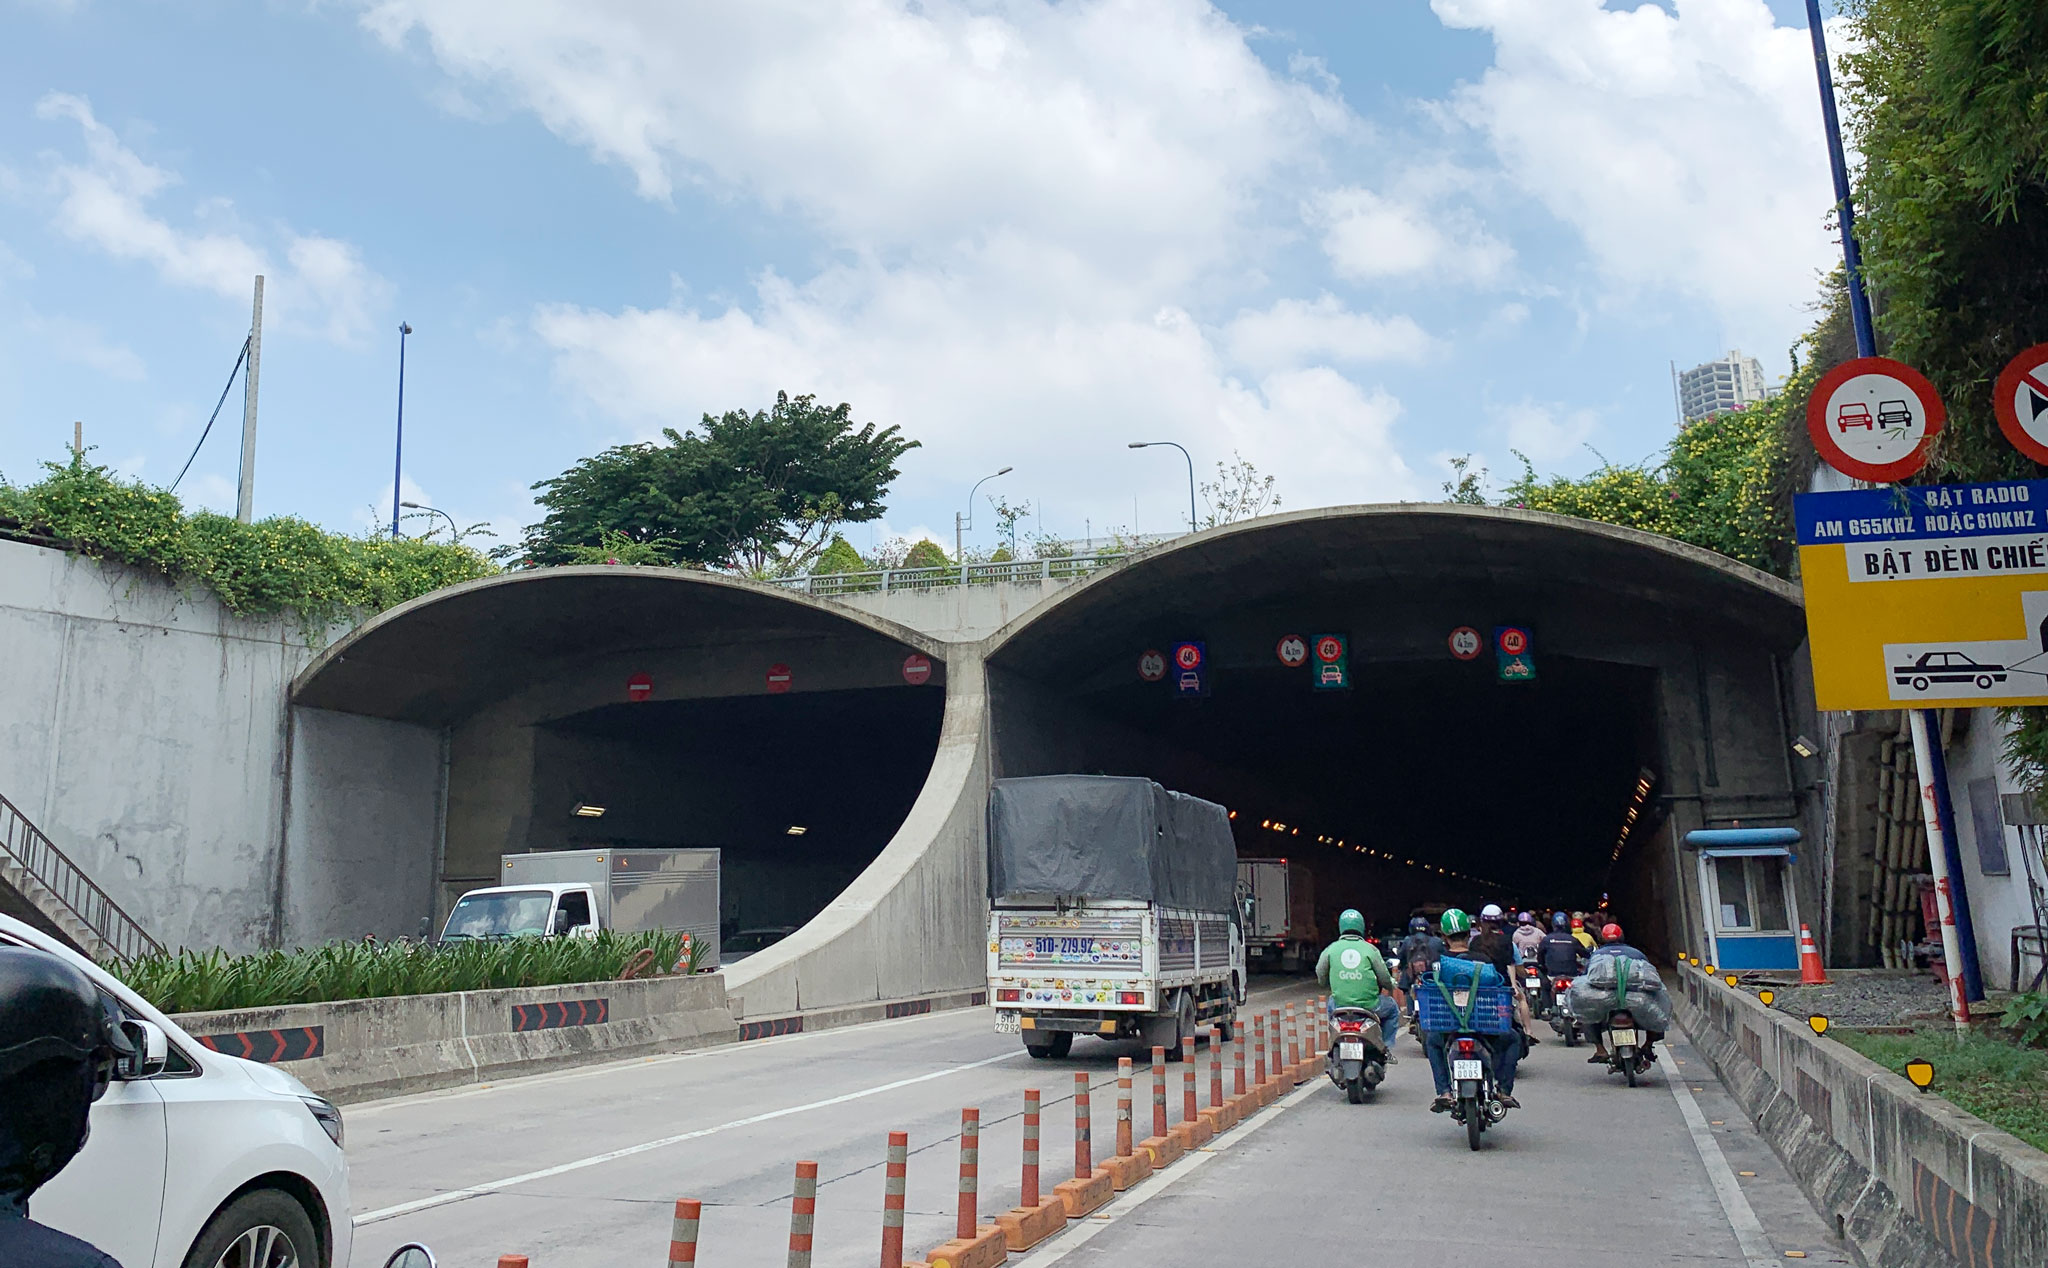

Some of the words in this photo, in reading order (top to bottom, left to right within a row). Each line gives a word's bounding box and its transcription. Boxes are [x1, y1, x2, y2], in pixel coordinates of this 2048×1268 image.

[1926, 486, 1963, 509] BẬT
[1971, 485, 2030, 505] RADIO
[1814, 520, 1843, 538] AM
[1849, 516, 1916, 536] 655KHZ
[1925, 511, 1975, 534] HOẶC
[1978, 510, 2036, 529] 610KHZ
[1864, 547, 1912, 580] BẬT
[1924, 544, 1979, 573] ĐÈN
[1986, 537, 2048, 570] CHIẾ
[1507, 635, 1519, 647] 40
[1183, 650, 1193, 662] 60
[1323, 643, 1334, 655] 60
[1061, 936, 1094, 954] 279.92
[1339, 969, 1362, 980] Grab
